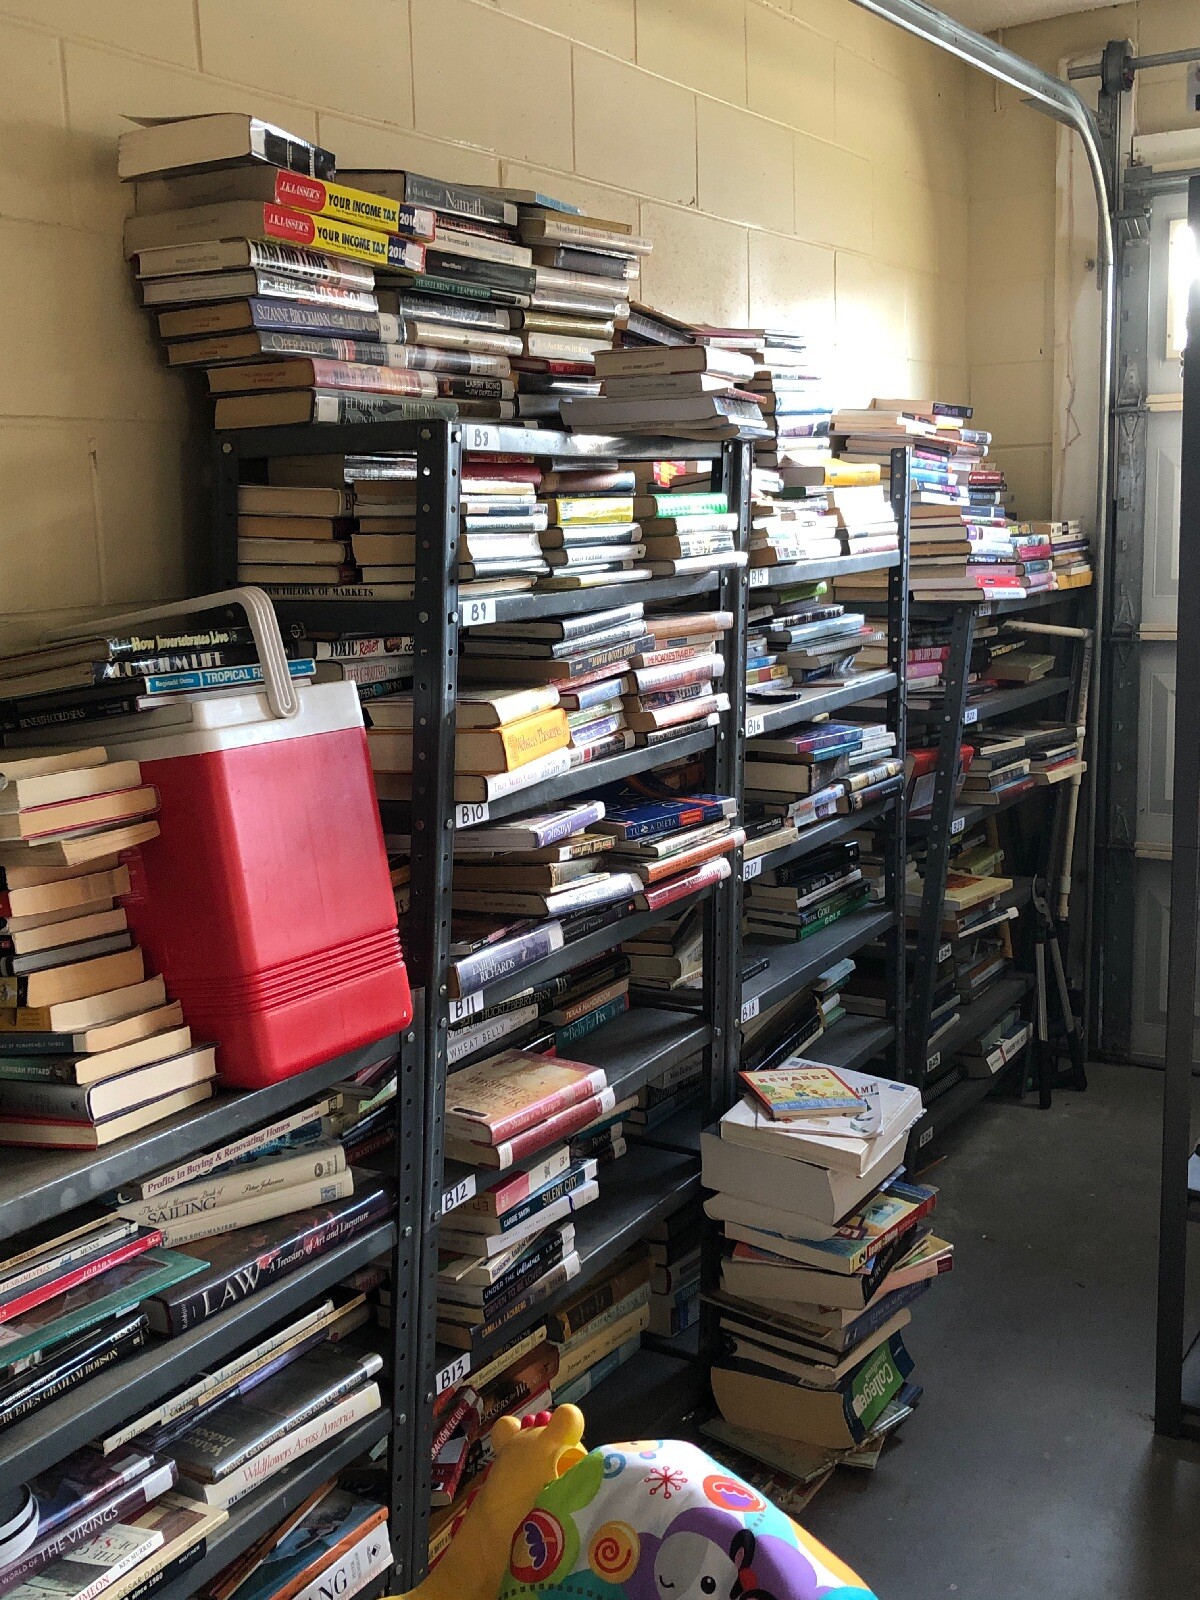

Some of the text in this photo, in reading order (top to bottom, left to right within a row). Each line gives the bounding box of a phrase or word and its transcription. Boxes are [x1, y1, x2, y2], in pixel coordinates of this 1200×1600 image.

[328, 193, 397, 222] YOUR INCOME TAX
[445, 190, 485, 216] Namath
[317, 226, 386, 255] YOUR INCOME TAX
[257, 304, 331, 327] SUZANNE BROCKMANN
[751, 570, 764, 584] B15
[282, 587, 374, 597] THEORY OF MARKETS
[470, 603, 488, 622] B9
[132, 636, 156, 652] How
[210, 630, 230, 645] Live
[329, 640, 358, 658] TOXIC
[103, 651, 225, 680] AQUARIUM LIFE
[655, 652, 668, 663] ROAD
[205, 669, 251, 685] TROPICAL
[19, 708, 86, 730] BENEATH COLD SEAS
[747, 719, 761, 734] B16
[461, 803, 484, 825] B10
[656, 818, 677, 830] DIETA
[744, 861, 758, 880] B17
[817, 904, 832, 919] GOLF
[823, 910, 842, 926] GOLF
[472, 955, 496, 976] EMILIE
[480, 957, 516, 984] RICHARDS
[455, 995, 475, 1019] B11
[481, 994, 534, 1020] HUCKLEBERRY
[449, 1023, 506, 1059] WHEAT BELLY
[757, 1074, 831, 1085] REWARDS
[147, 1120, 292, 1194] Profits in Buying & Renovating Homes
[444, 1183, 468, 1212] B12
[541, 1175, 578, 1206] SILENT CITY
[147, 1196, 218, 1226] SAILING
[268, 1211, 370, 1274] A Treasury of Art and Literature
[83, 1257, 114, 1279] JOBSON
[202, 1263, 261, 1317] LAW
[484, 1283, 504, 1300] UNDER
[504, 1272, 516, 1284] THE
[42, 1369, 85, 1400] GRAHAM
[85, 1347, 119, 1376] ROBSON
[441, 1359, 464, 1390] B13
[857, 1362, 894, 1409] College
[204, 1386, 229, 1400] CHRISTO
[242, 1409, 356, 1483] Wildflowers Across America
[1, 1563, 28, 1586] WORLD
[27, 1559, 39, 1572] OF
[39, 1541, 65, 1564] THE
[65, 1506, 120, 1544] VIKINGS
[118, 1541, 153, 1570] KEN MURRAY
